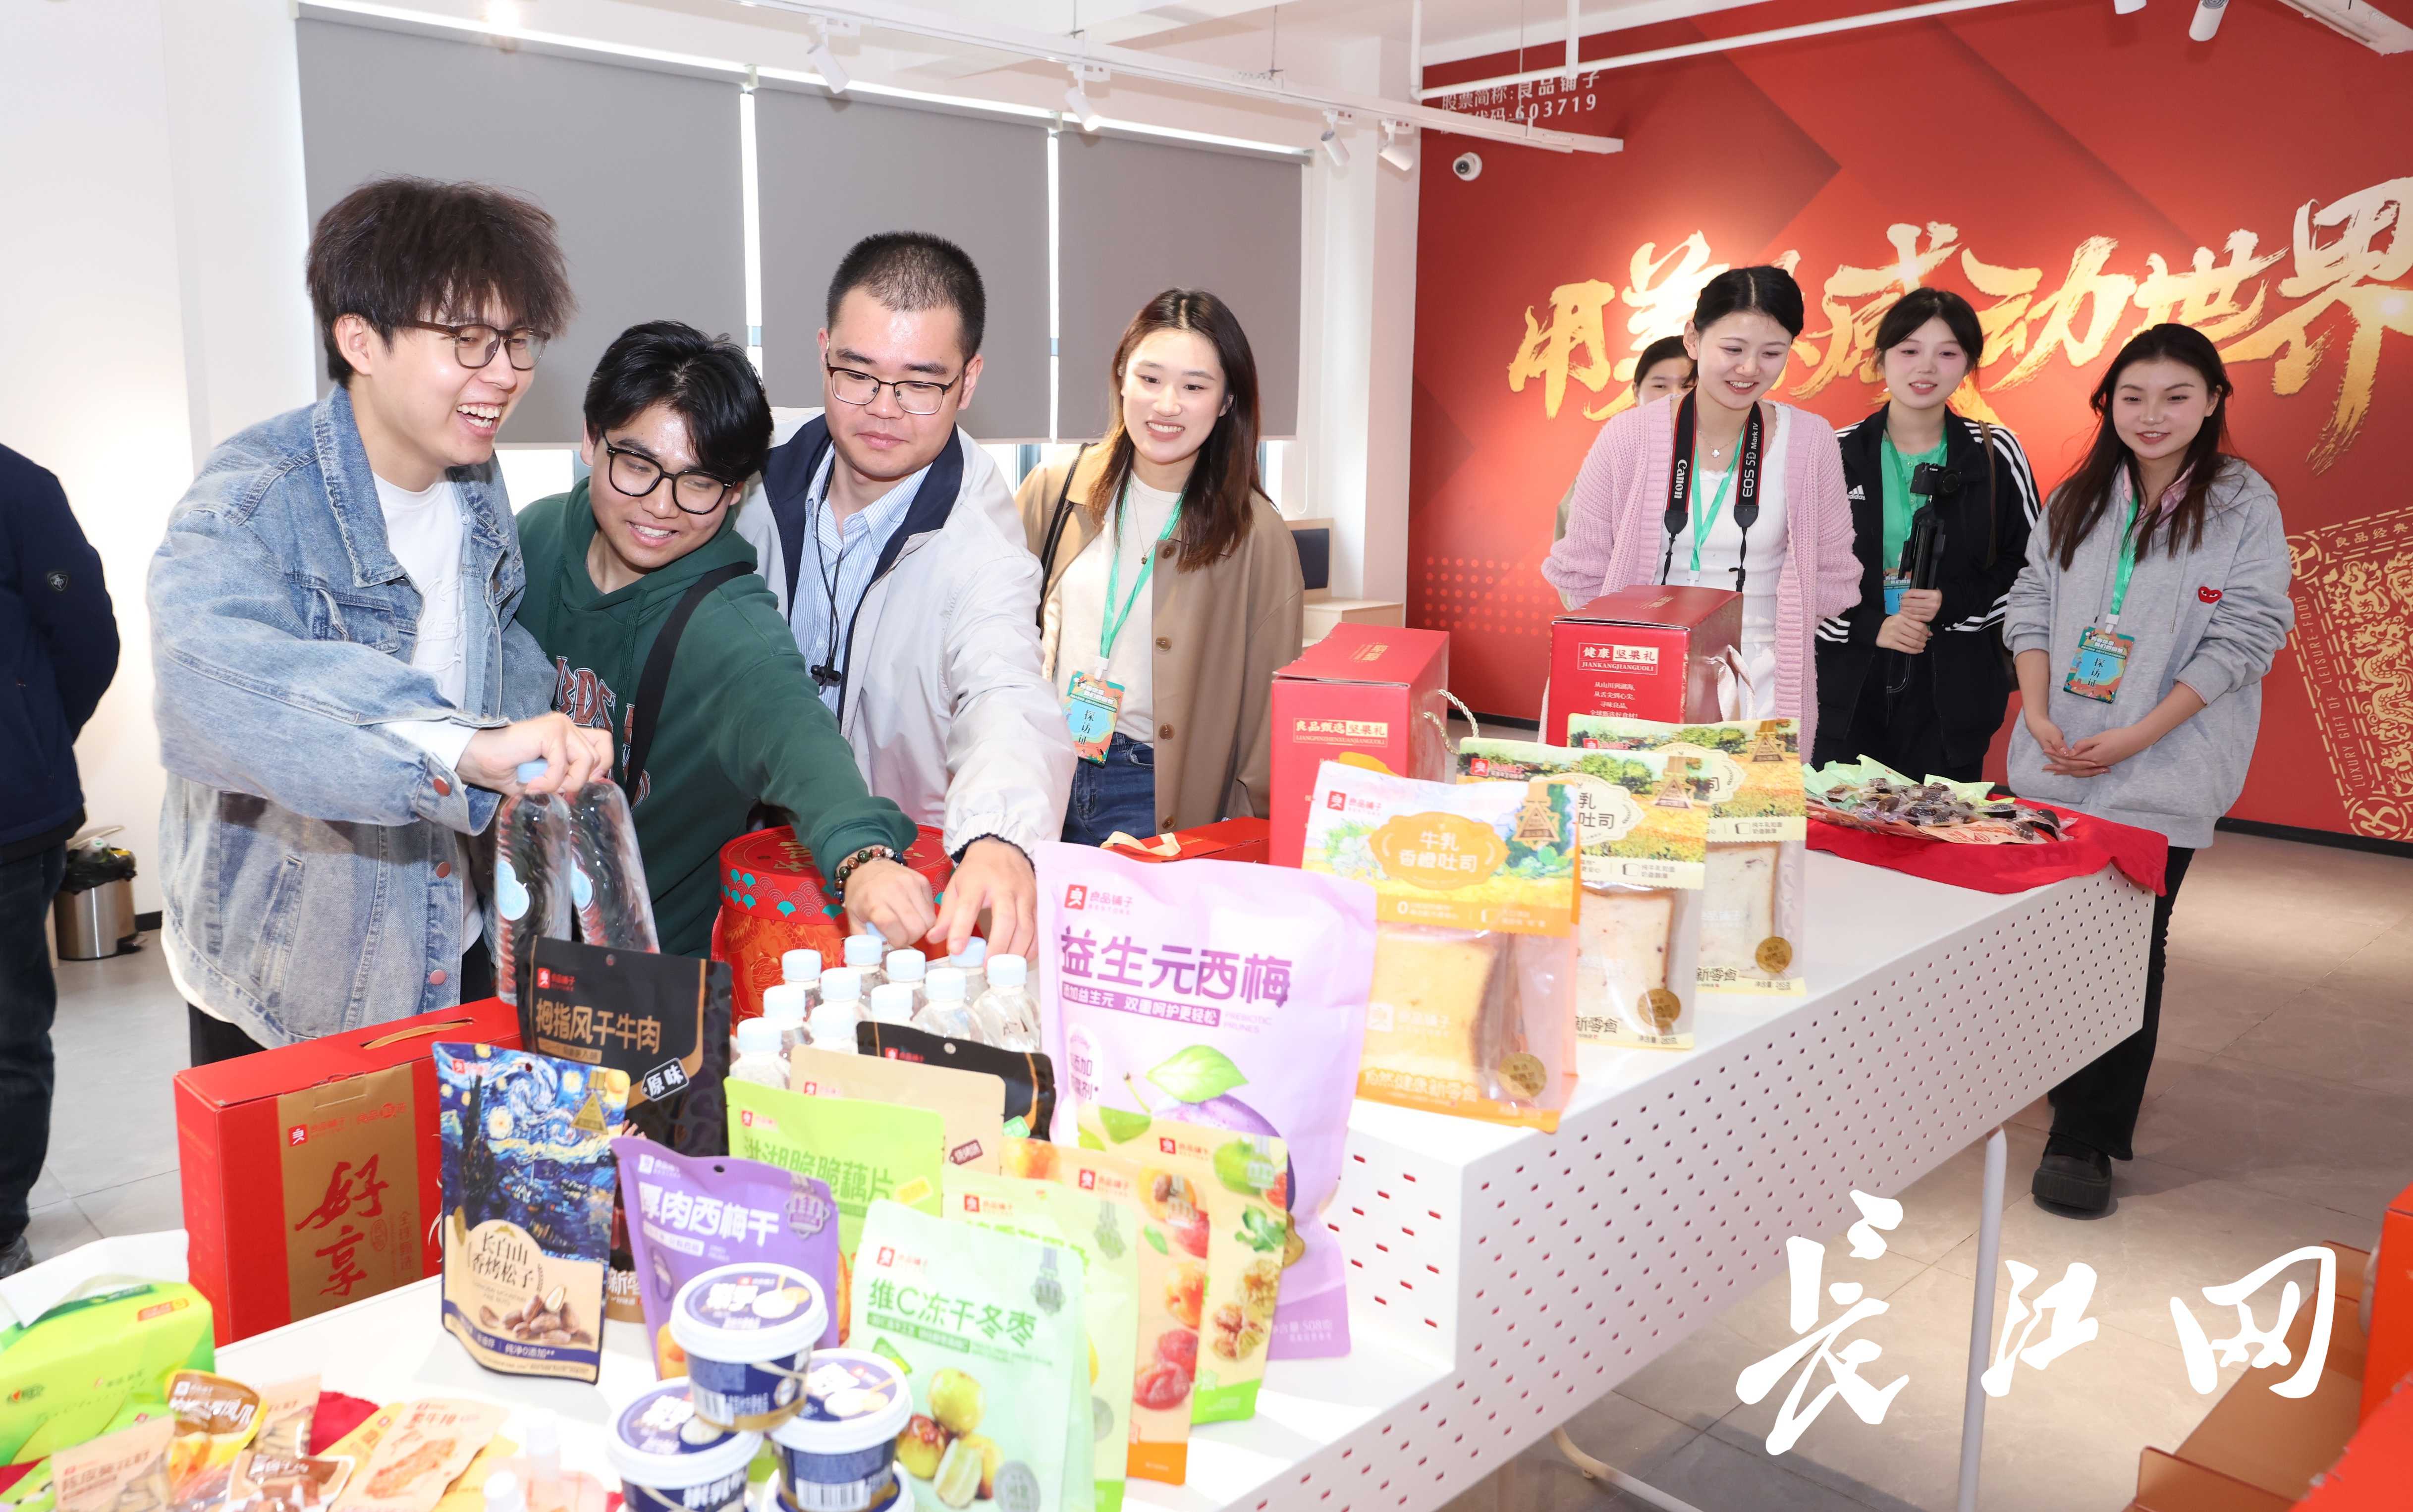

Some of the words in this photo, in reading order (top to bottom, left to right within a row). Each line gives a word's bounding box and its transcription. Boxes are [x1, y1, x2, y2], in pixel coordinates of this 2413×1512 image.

[1745, 451, 1756, 467] 5D
[1674, 458, 1688, 499] Canon
[1742, 469, 1755, 497] EOS
[1583, 647, 1655, 661] 健康坚果礼
[2295, 594, 2331, 685] LEISURE-FOOD
[2327, 695, 2340, 710] OF
[2334, 713, 2349, 740] GIFT
[2342, 745, 2365, 788] LUXURY
[1578, 813, 1615, 829] 吐司
[1420, 831, 1459, 852] 牛乳
[1060, 925, 1292, 1009] 益生元西梅
[536, 998, 661, 1055] 拇指风干牛肉
[1124, 995, 1218, 1026] 双重呵护更轻松
[646, 1064, 684, 1097] 原味
[638, 1182, 779, 1248] 厚肉西梅干
[482, 1231, 528, 1266] 长白山
[471, 1252, 534, 1289] 香烤松子
[867, 1276, 1039, 1349] 维C冻干冬枣
